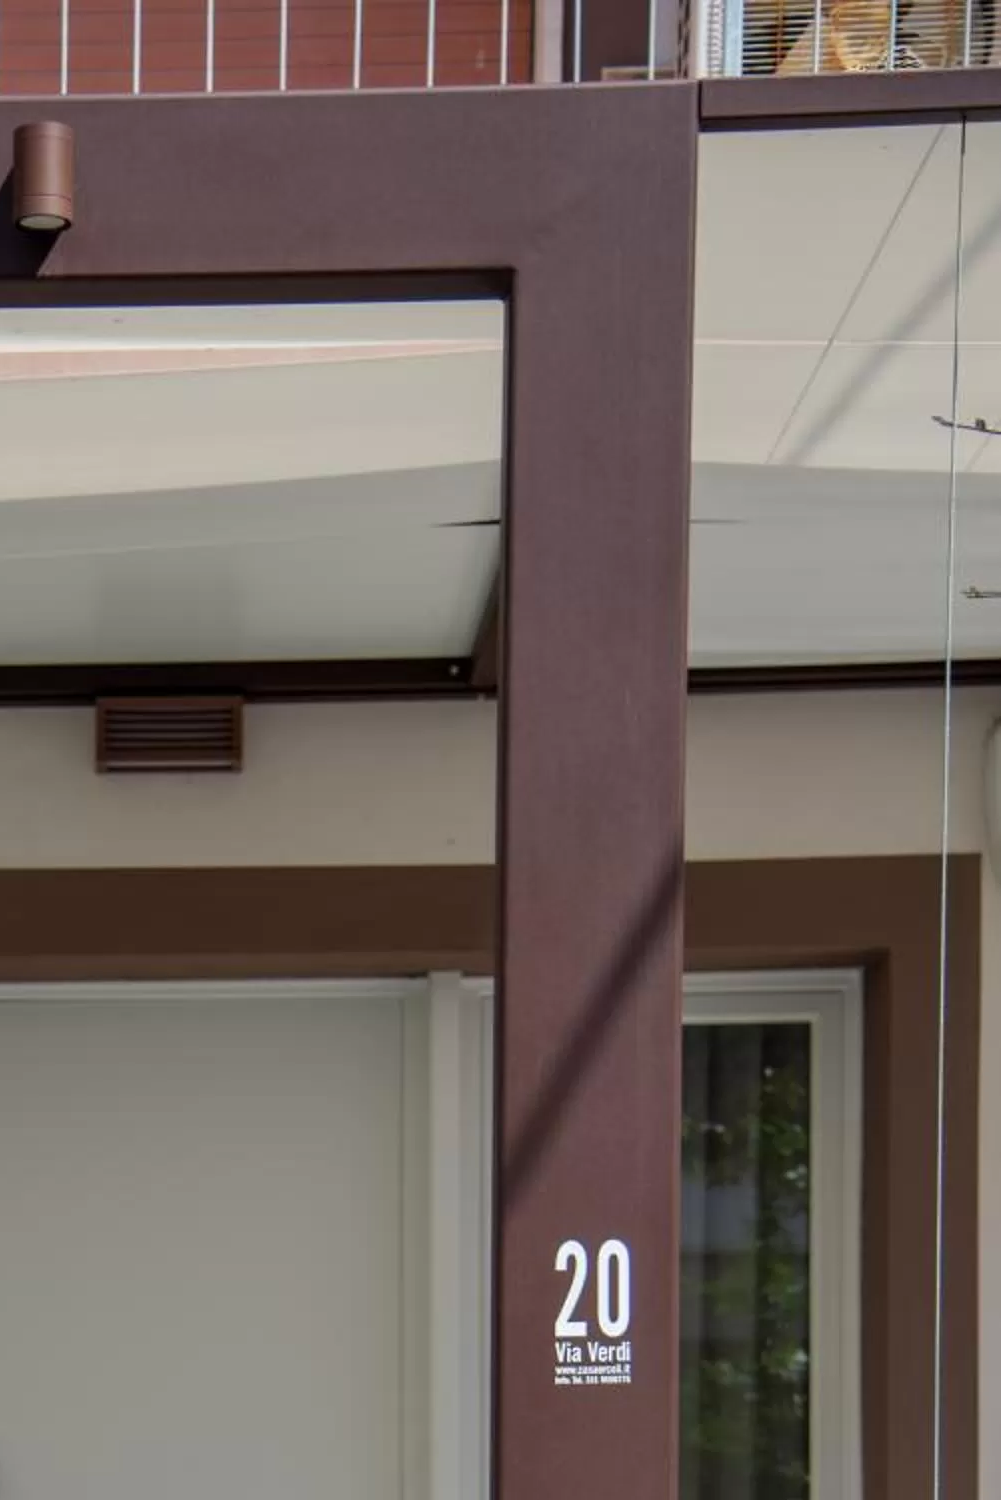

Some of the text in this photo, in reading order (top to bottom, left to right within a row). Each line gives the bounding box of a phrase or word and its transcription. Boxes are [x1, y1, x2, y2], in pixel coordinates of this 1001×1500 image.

[554, 1239, 630, 1338] 20
[555, 1341, 631, 1363] Via Verdi
